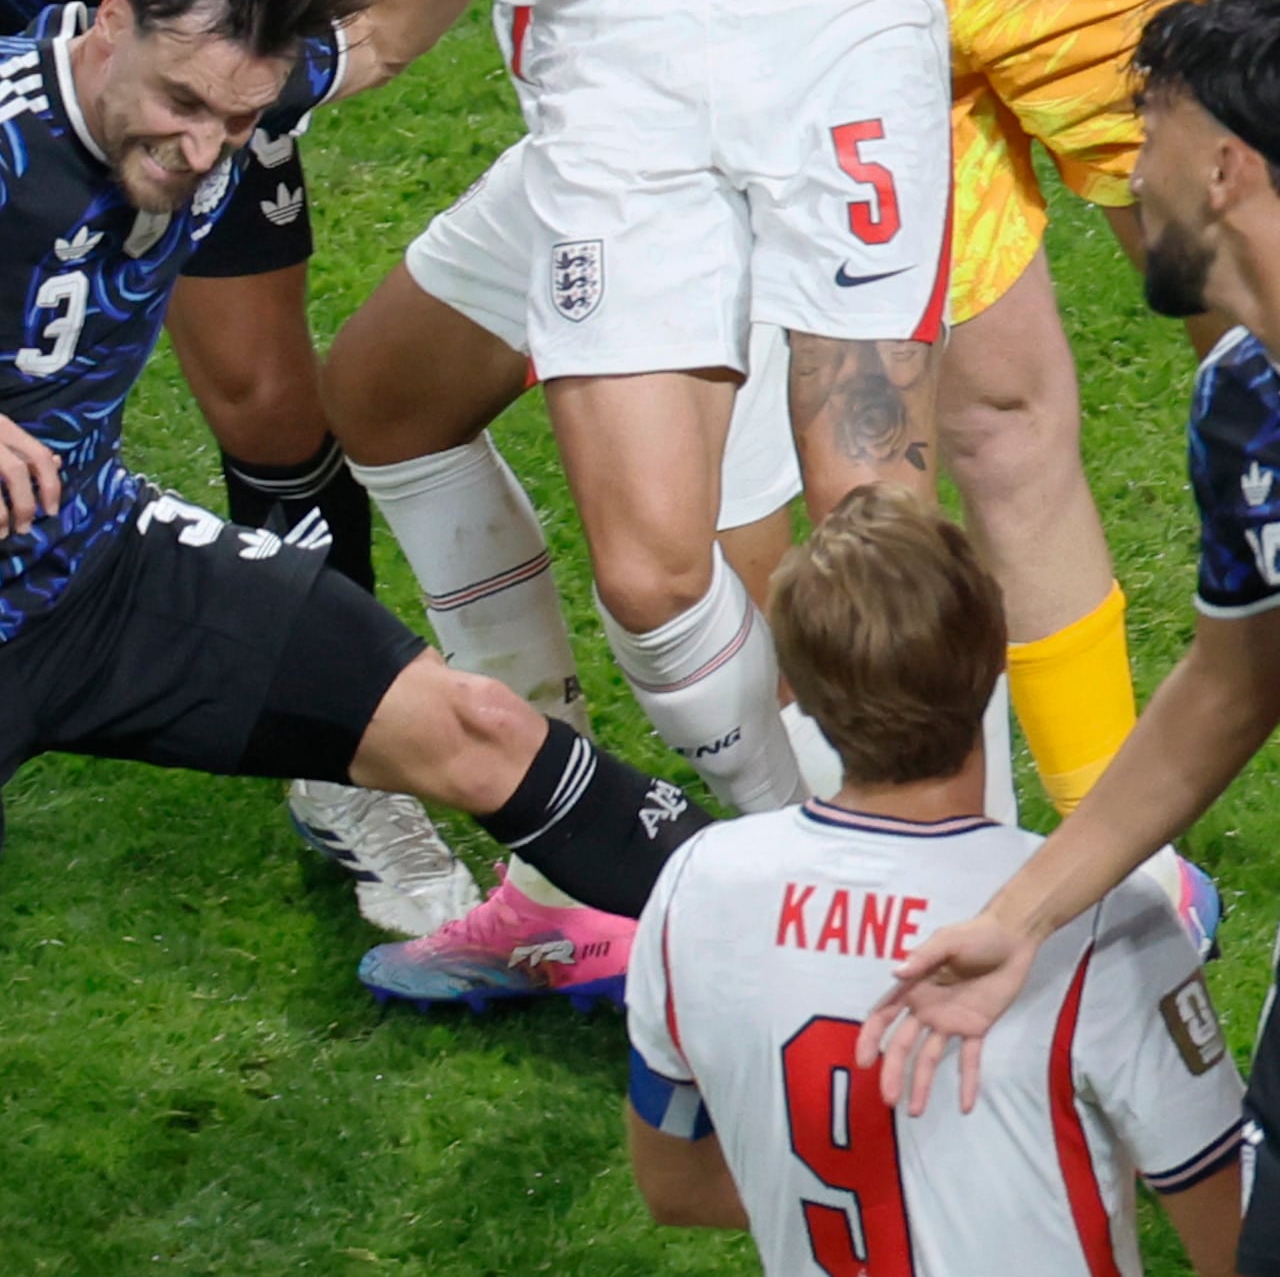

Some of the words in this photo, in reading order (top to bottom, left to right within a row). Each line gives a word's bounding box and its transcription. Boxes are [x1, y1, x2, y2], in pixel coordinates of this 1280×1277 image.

[830, 118, 902, 245] 5
[15, 270, 89, 378] 3
[136, 495, 225, 547] 3
[775, 882, 928, 961] KANE
[782, 1015, 914, 1277] 9
